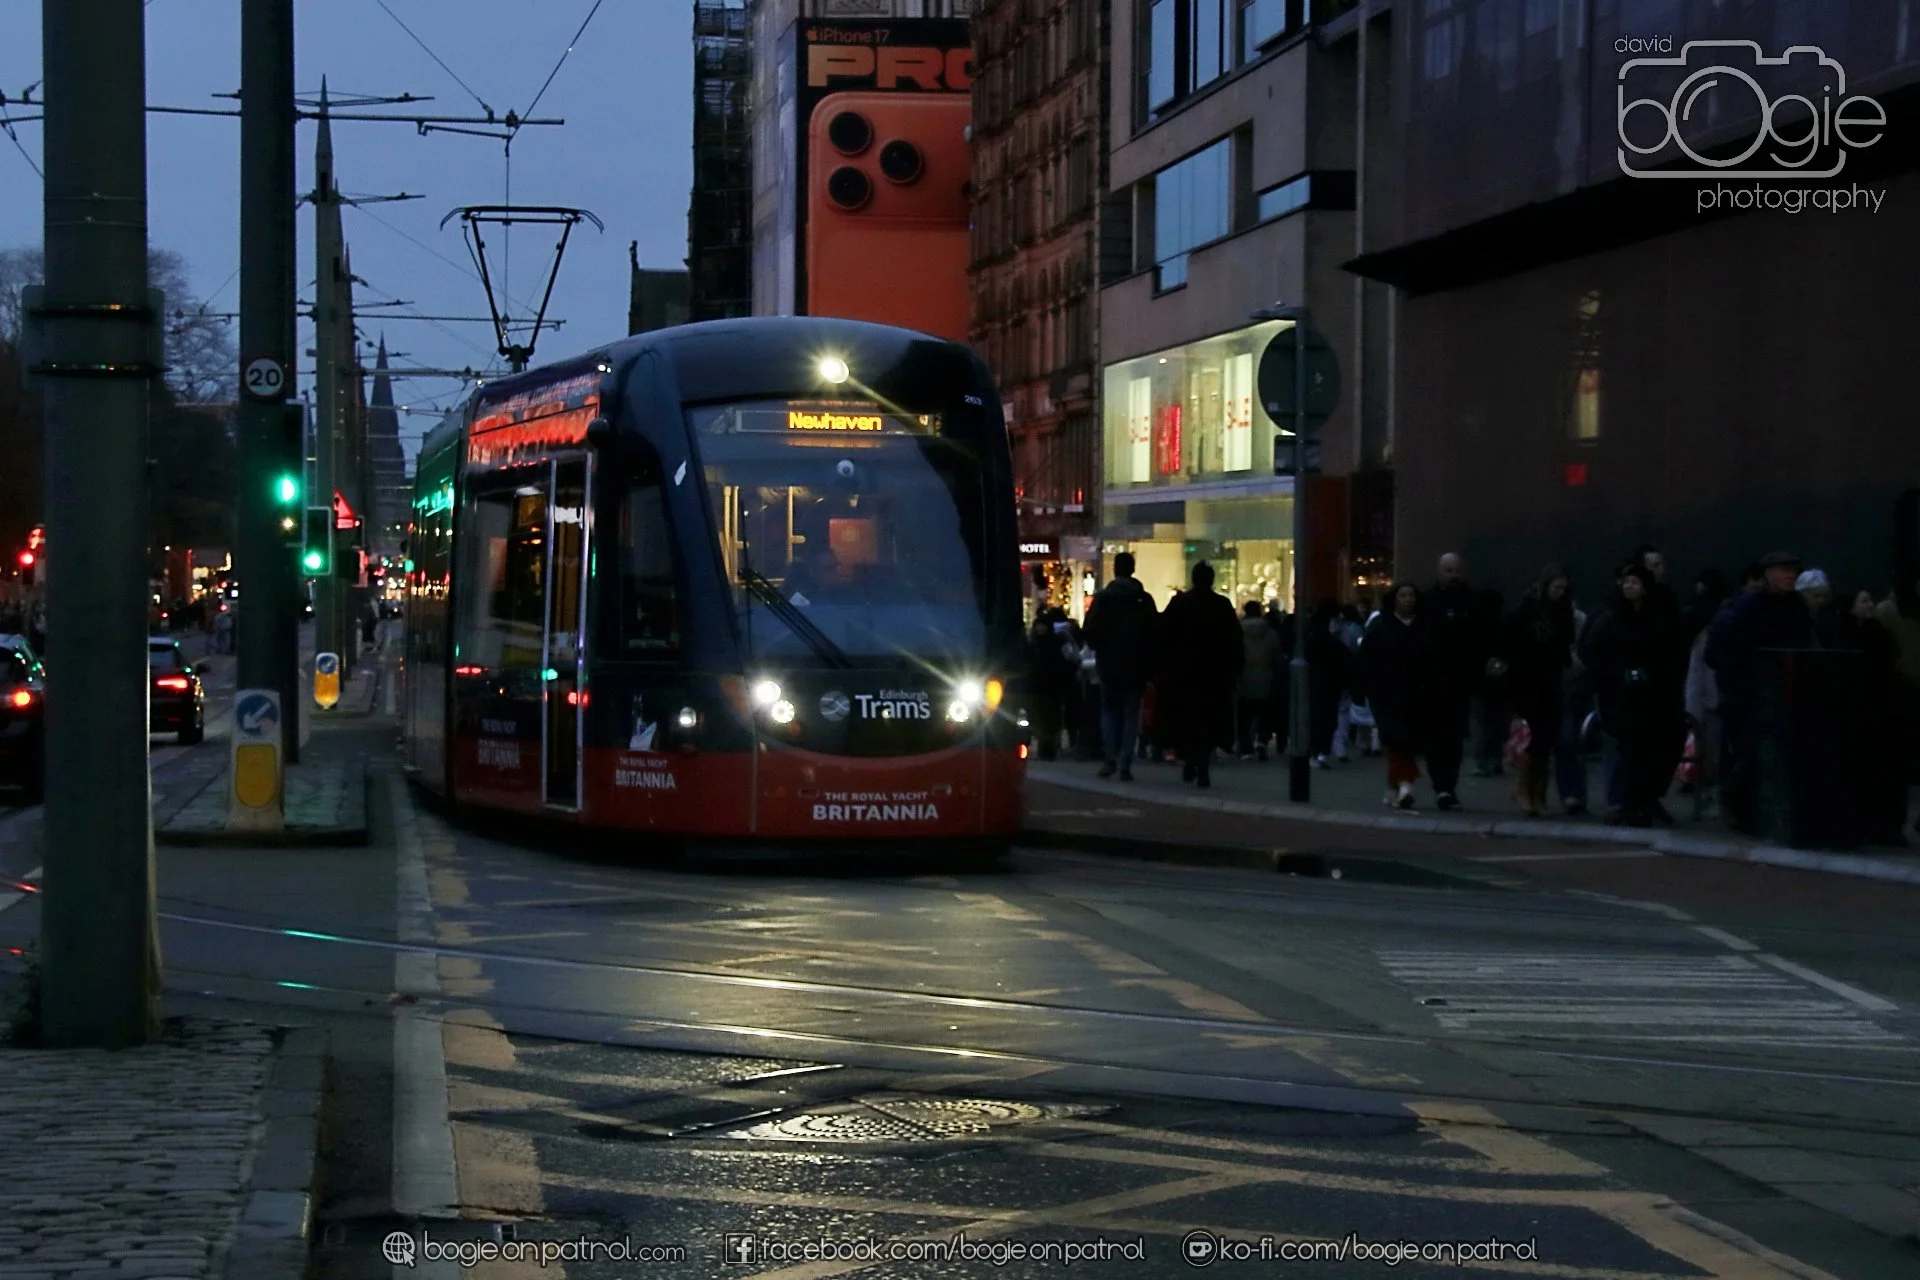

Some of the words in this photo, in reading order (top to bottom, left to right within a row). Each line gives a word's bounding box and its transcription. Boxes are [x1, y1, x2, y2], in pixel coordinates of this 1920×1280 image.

[819, 27, 872, 43] iPhone
[875, 28, 891, 43] 17
[248, 368, 281, 387] 20
[788, 411, 883, 431] Newhaven
[879, 689, 929, 702] Edinburgh
[854, 694, 931, 720] Trams
[615, 768, 676, 789] BRITANNIA
[824, 791, 849, 801] THE
[851, 791, 889, 801] ROYAL
[891, 791, 929, 801] YACHT
[812, 803, 939, 821] BRITANNIA
